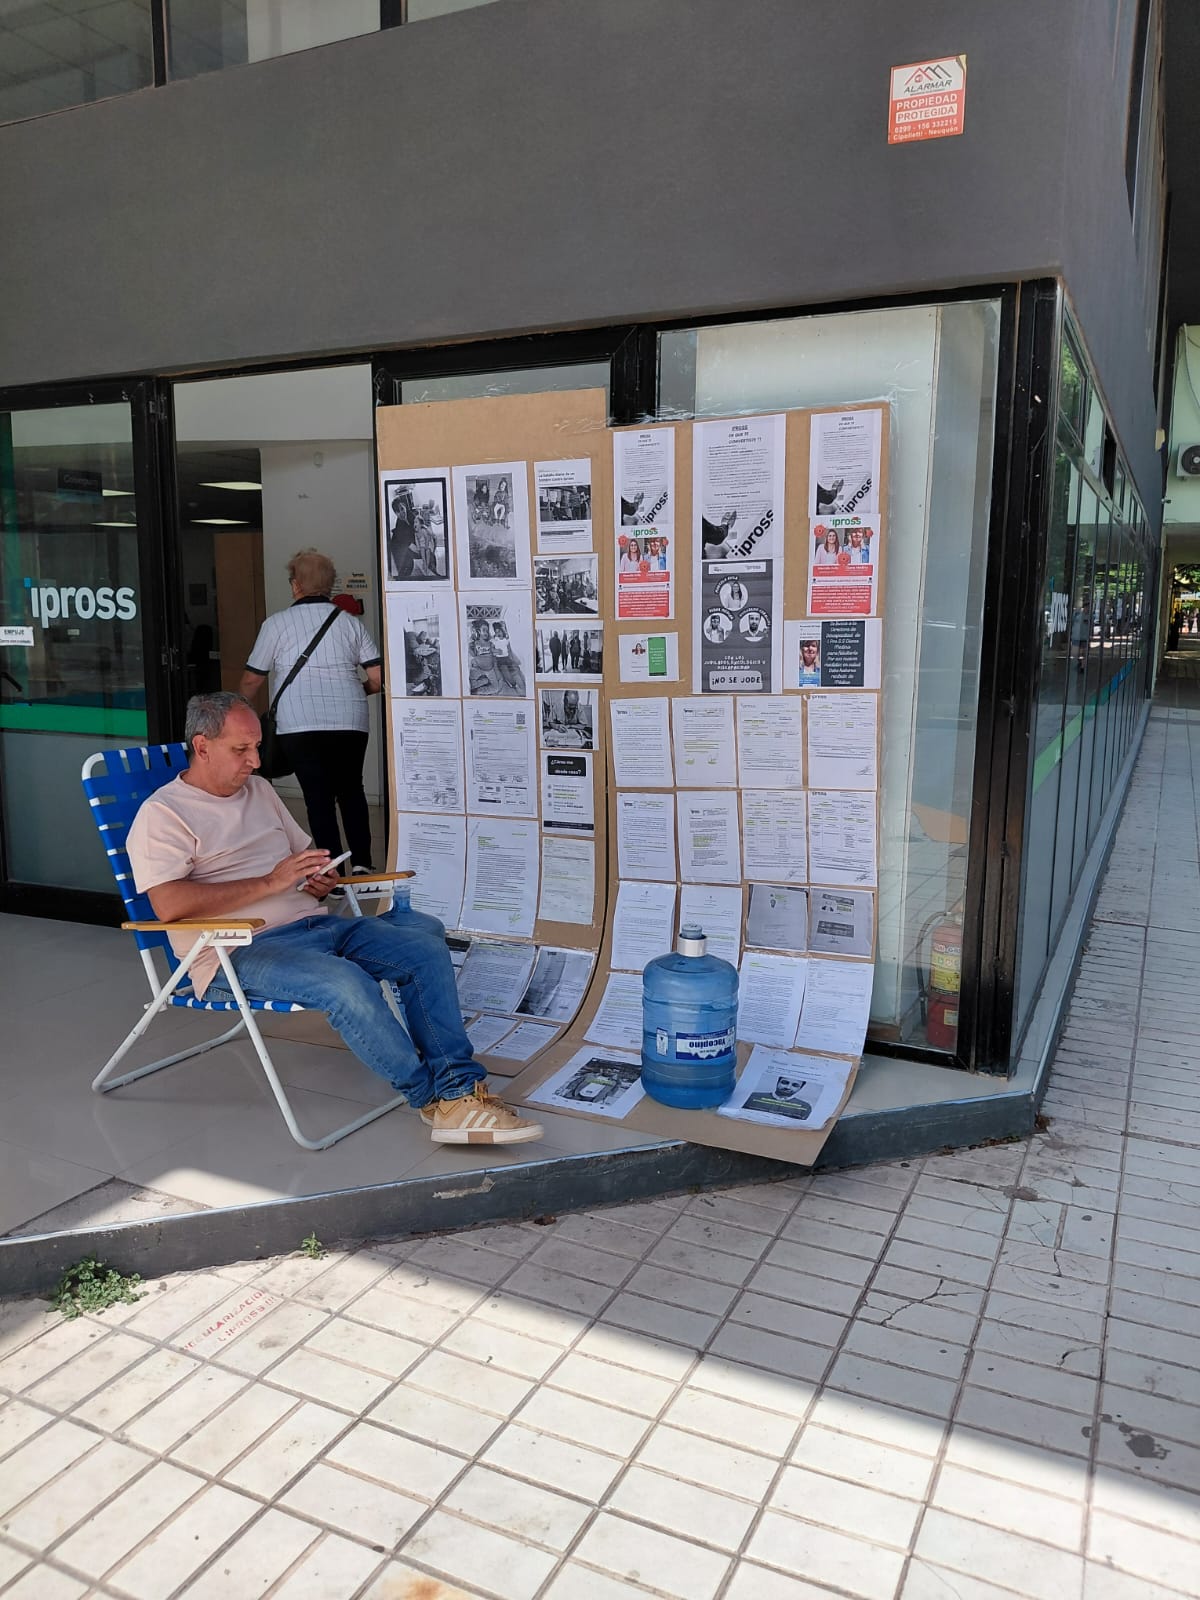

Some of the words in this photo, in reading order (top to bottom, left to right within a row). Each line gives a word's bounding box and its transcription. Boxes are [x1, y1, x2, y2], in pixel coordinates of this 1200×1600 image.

[904, 79, 952, 93] ALARMAR
[896, 93, 957, 111] PROPIEDAD
[897, 105, 955, 122] PROTEGIDA
[734, 510, 773, 556] ipross
[28, 580, 137, 629] ipross
[689, 1038, 726, 1050] Yacopino
